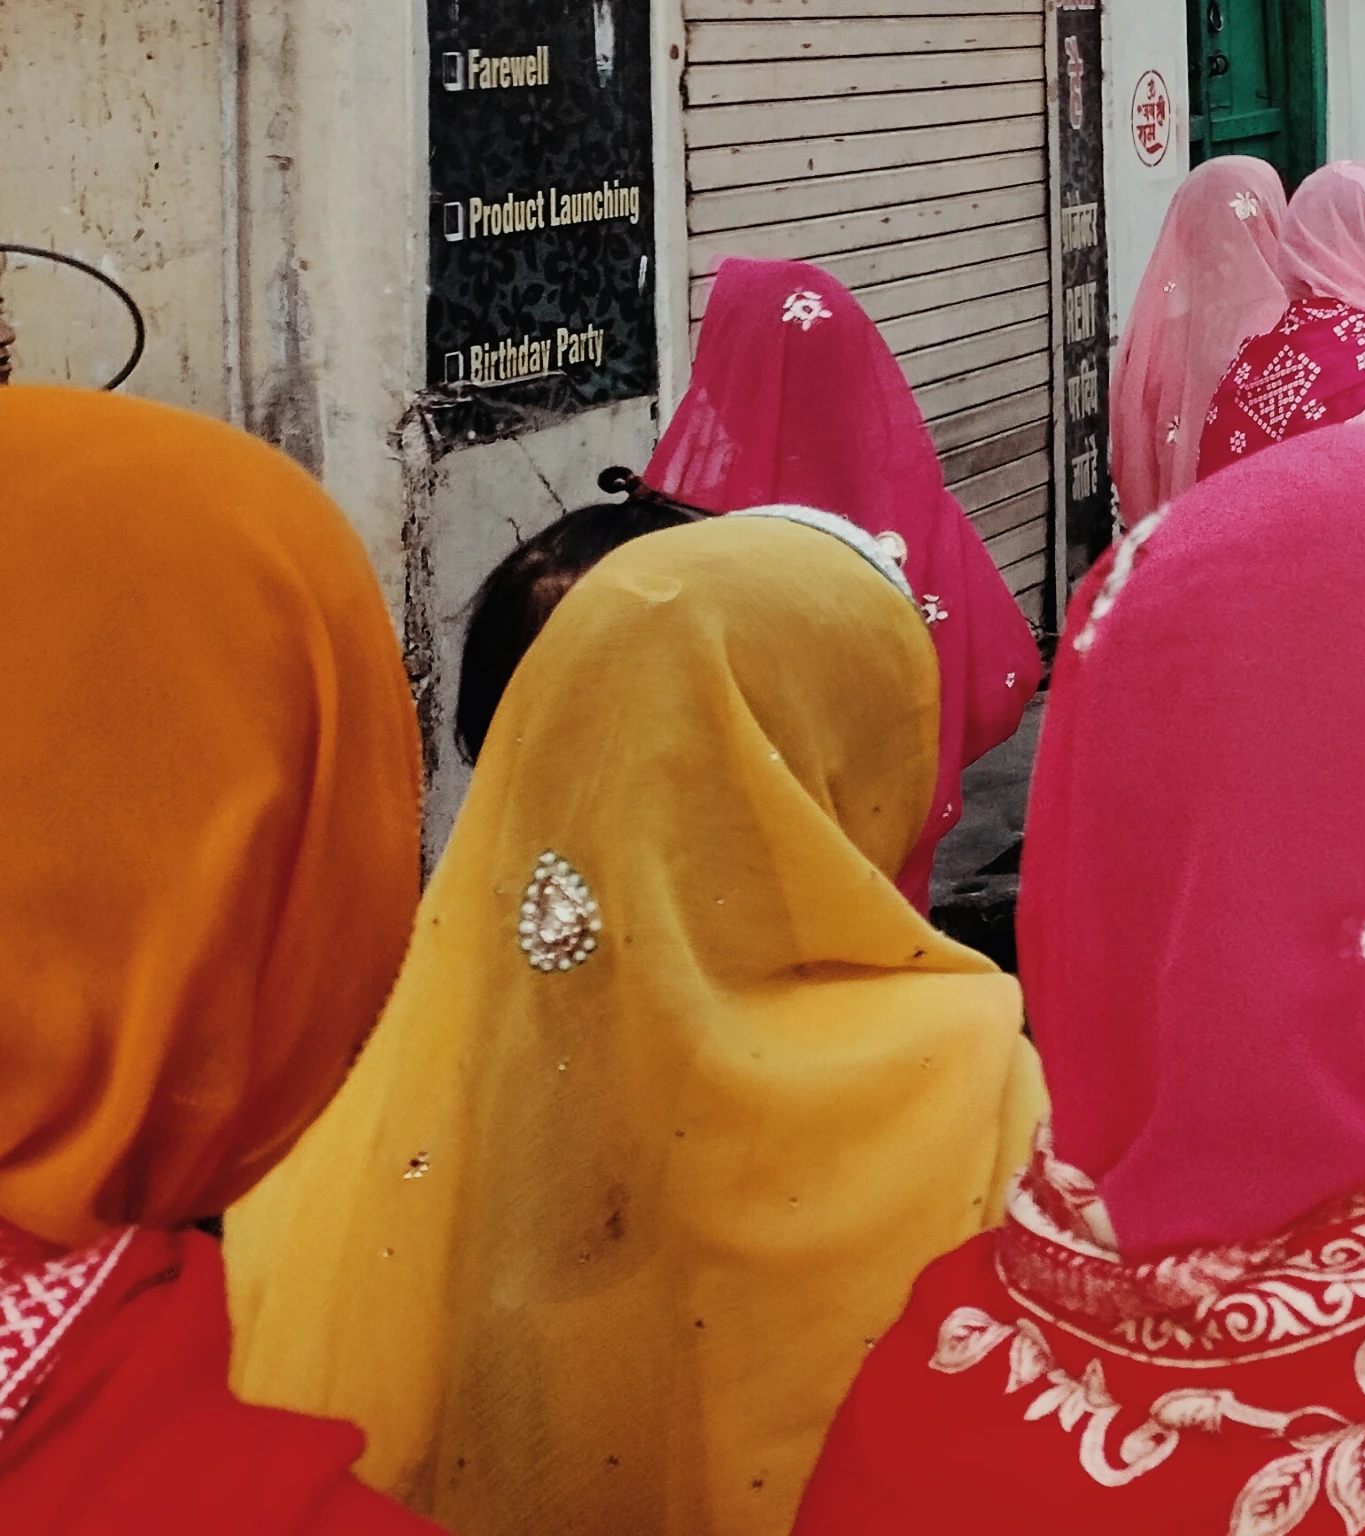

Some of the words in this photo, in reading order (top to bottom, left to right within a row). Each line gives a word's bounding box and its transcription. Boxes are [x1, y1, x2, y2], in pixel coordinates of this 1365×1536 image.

[467, 45, 549, 90] Farewell
[469, 189, 544, 239] Product
[549, 179, 639, 228] Launching
[1066, 280, 1097, 345] RENT
[470, 334, 551, 382] Birthday
[557, 323, 604, 367] Party
